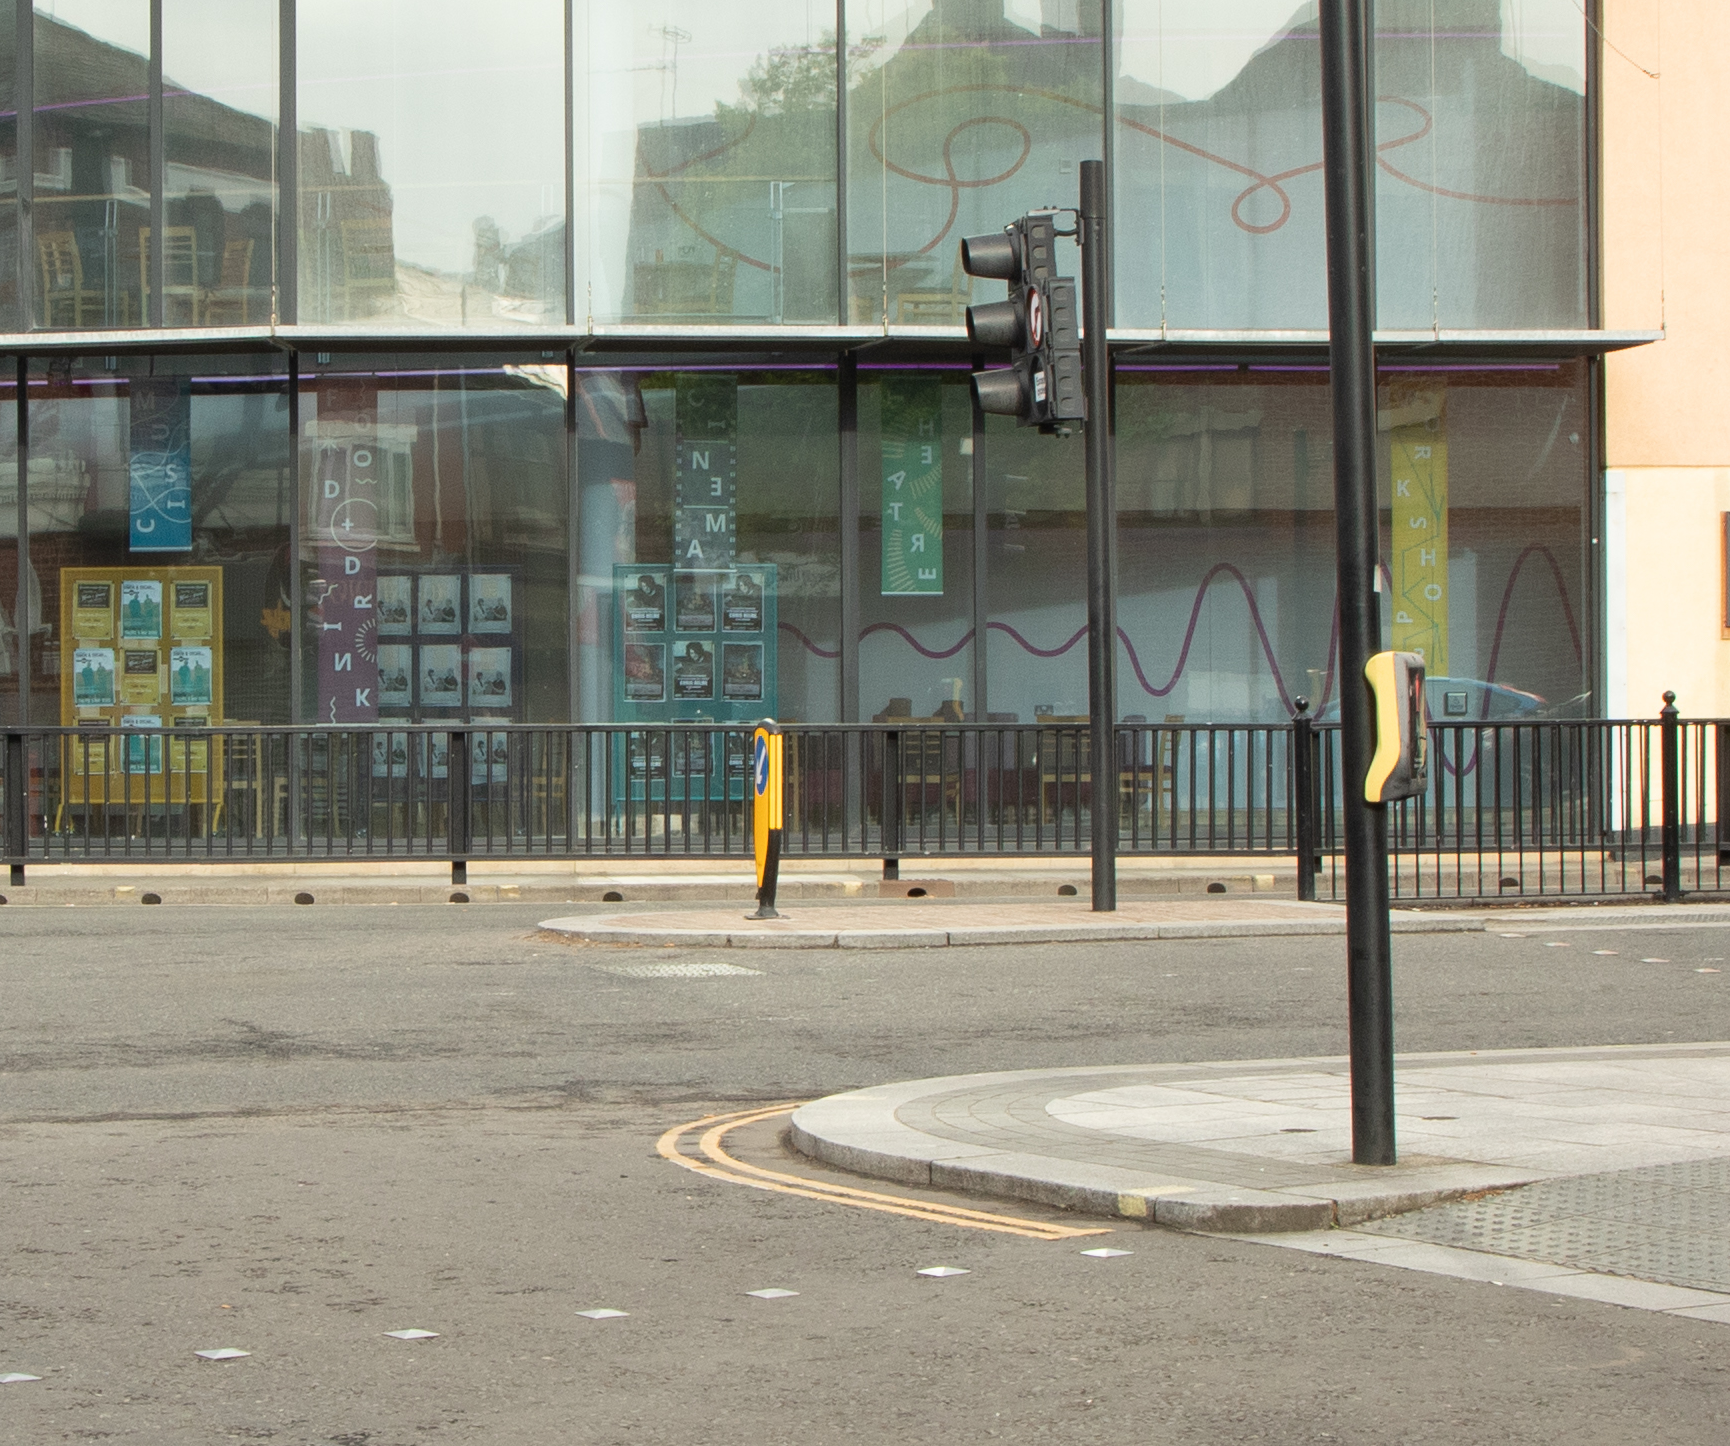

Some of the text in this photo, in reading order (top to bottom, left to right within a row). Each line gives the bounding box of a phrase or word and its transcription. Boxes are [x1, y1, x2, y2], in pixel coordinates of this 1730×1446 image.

[135, 391, 186, 534] MUSIC
[687, 388, 727, 559] CINEMA
[887, 394, 937, 580] THEATRE
[324, 556, 373, 708] DRINK
